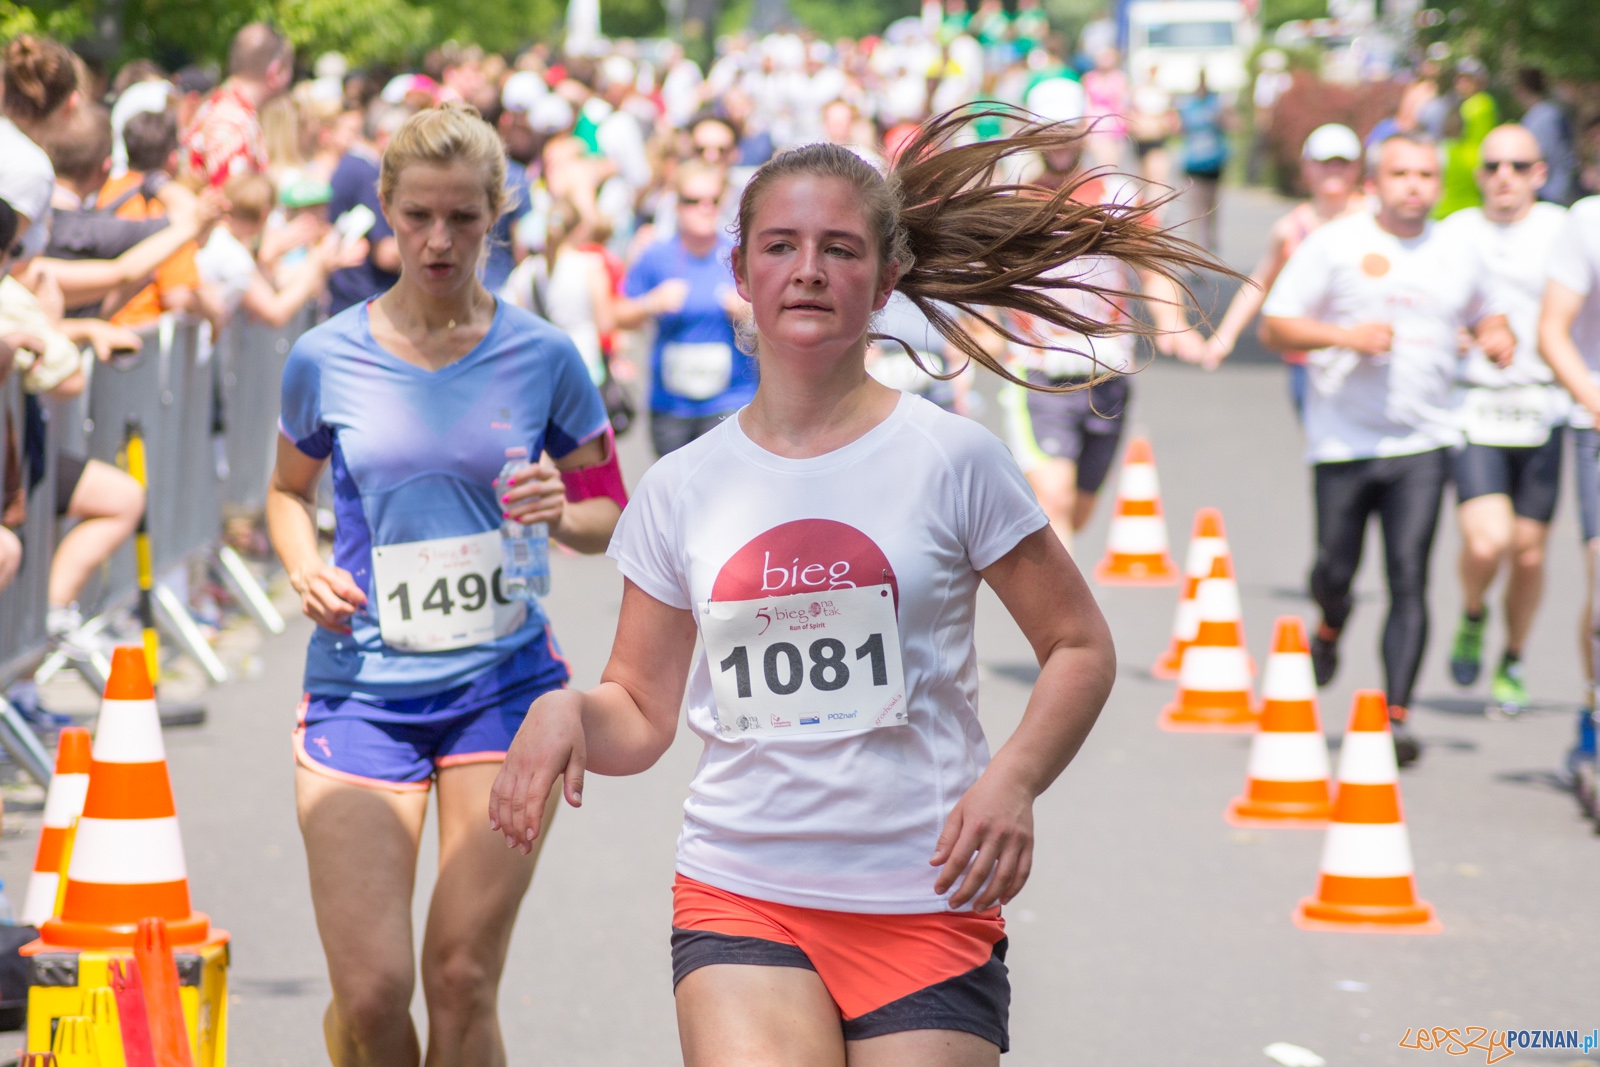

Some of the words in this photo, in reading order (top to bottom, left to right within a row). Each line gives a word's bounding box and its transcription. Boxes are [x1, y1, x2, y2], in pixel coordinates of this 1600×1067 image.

[760, 550, 858, 592] bieg
[755, 606, 772, 636] 5
[774, 606, 810, 624] bieg
[820, 600, 834, 608] na
[809, 621, 826, 630] Spirit
[823, 606, 842, 617] tak
[719, 633, 888, 698] 1081
